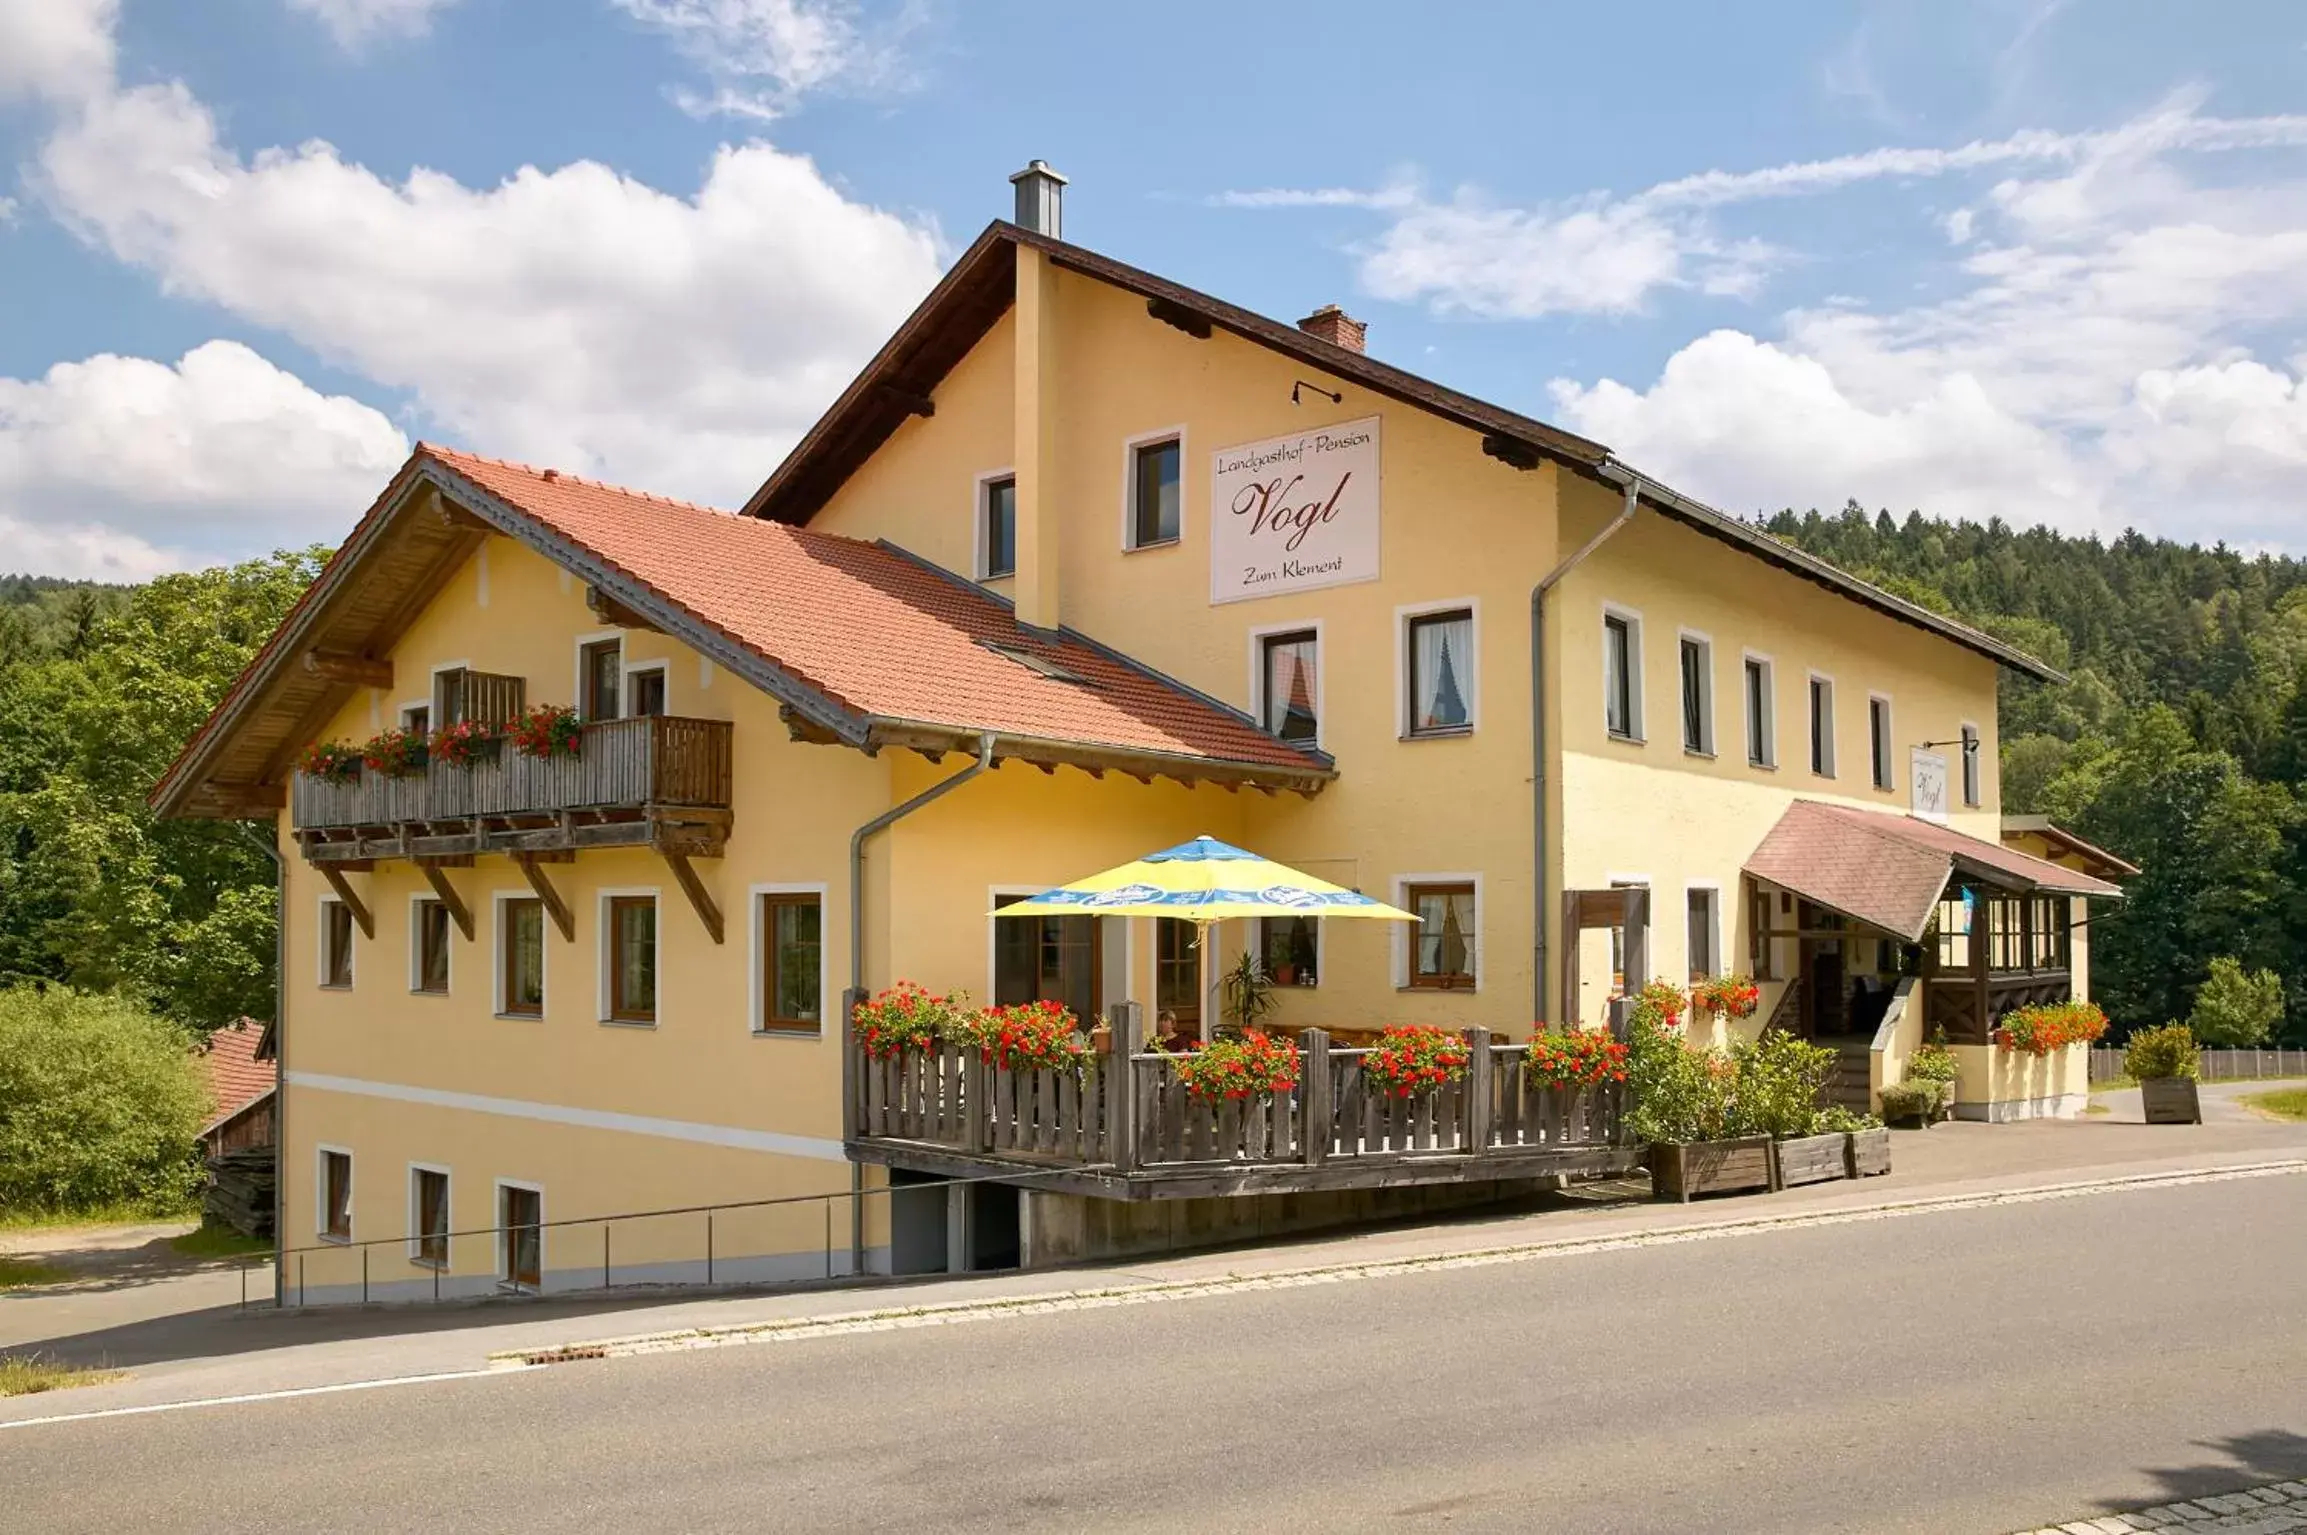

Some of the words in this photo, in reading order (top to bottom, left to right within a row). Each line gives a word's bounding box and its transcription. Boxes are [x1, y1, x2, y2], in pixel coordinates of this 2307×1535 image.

[1231, 471, 1352, 552] Vogl
[1243, 566, 1278, 585] Zum
[1283, 556, 1342, 578] Klement
